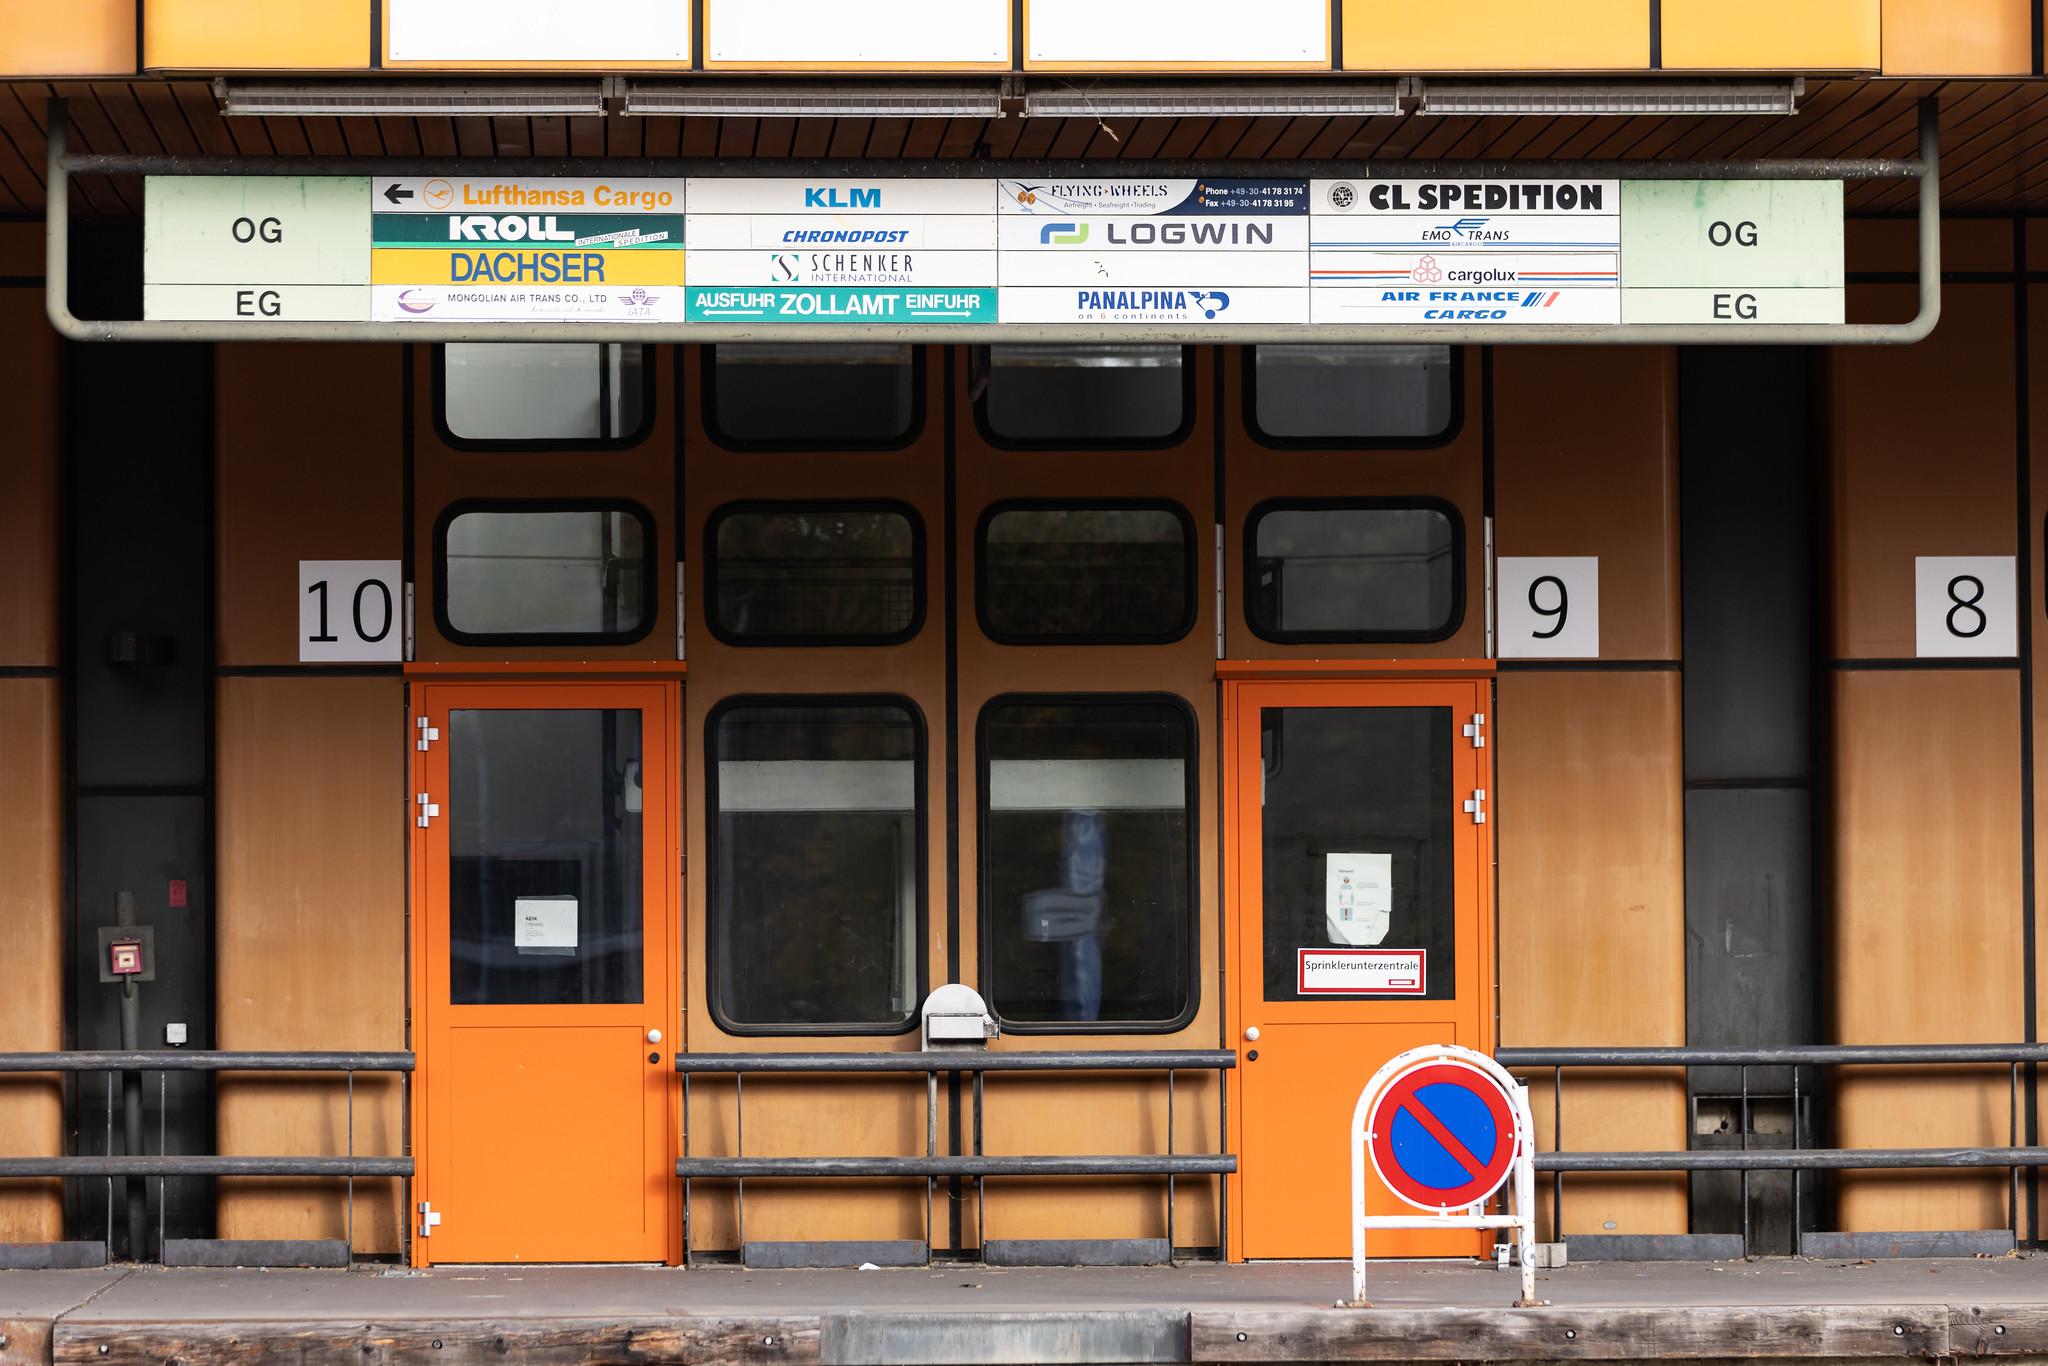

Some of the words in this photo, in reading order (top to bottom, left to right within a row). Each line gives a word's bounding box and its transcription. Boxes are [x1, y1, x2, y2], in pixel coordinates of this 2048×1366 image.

[463, 184, 585, 206] Lufthansa
[593, 185, 673, 211] Cargo
[805, 188, 881, 208] KLM
[1052, 185, 1101, 197] FLYING
[1111, 185, 1167, 197] WHEELS
[1205, 187, 1228, 195] Phone
[1369, 184, 1410, 210] CL
[1417, 184, 1603, 210] SPEDITION
[1064, 201, 1093, 209] Airfreight
[1098, 201, 1130, 209] Seafreight
[1205, 199, 1219, 207] Fax
[232, 217, 283, 243] OG
[449, 216, 575, 241] KROLL
[782, 230, 909, 243] CHRONOPOST
[1107, 223, 1273, 245] LOGWIN
[1422, 230, 1451, 240] EMO
[1468, 230, 1509, 240] TRANS
[1708, 221, 1758, 247] OG
[578, 231, 636, 245] INTERNATIONALE
[618, 233, 664, 246] SPEDITION
[451, 253, 605, 282] DACHSER
[811, 254, 913, 272] SCHENKER
[811, 274, 913, 283] INTERNATIONAL
[1448, 268, 1516, 284] cargolux
[236, 290, 281, 317] EG
[447, 293, 507, 303] MONGOLIAN
[510, 293, 526, 303] AIR
[530, 293, 561, 303] TRANS
[589, 294, 607, 303] LTD
[696, 293, 775, 308] AUSFUHR
[779, 293, 900, 315] ZOLLAMT
[905, 294, 981, 309] EINFUHR
[1078, 291, 1187, 310] PANALPINA
[1381, 291, 1420, 302] AIR
[1429, 291, 1520, 302] FRANCE
[1423, 309, 1507, 320] CARGO
[1714, 293, 1758, 320] EG
[1100, 312, 1107, 320] 6
[1113, 312, 1188, 320] continents
[308, 578, 393, 643] 10
[1527, 575, 1569, 639] 9
[1945, 575, 1987, 639] 8
[1305, 960, 1419, 972] Sprinklerunterzentrale
